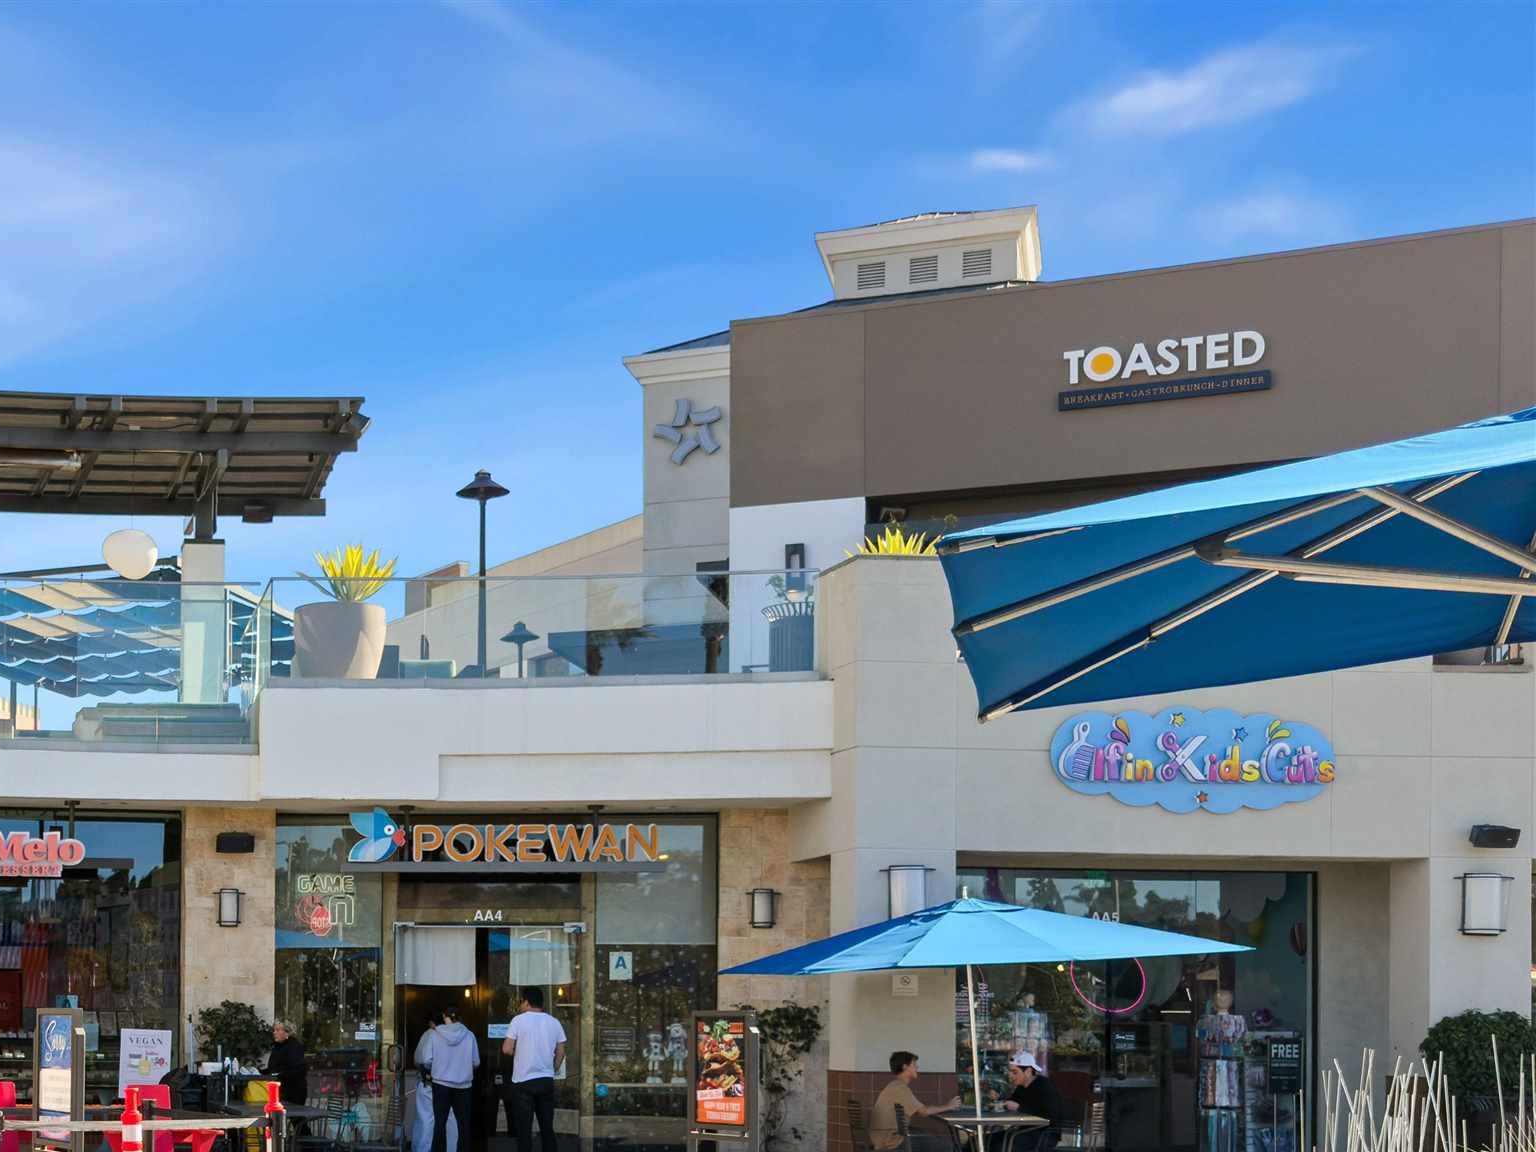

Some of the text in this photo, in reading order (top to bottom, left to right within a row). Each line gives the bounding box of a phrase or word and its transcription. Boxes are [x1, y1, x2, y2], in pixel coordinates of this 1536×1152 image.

[1063, 330, 1265, 385] TOASTED
[1261, 740, 1336, 784] Cuts
[413, 823, 659, 862] POKEWAN
[297, 874, 355, 893] GAME
[473, 909, 503, 922] AA4
[615, 956, 627, 969] A
[129, 1037, 163, 1045] VEGAN
[1271, 1044, 1300, 1058] FREE
